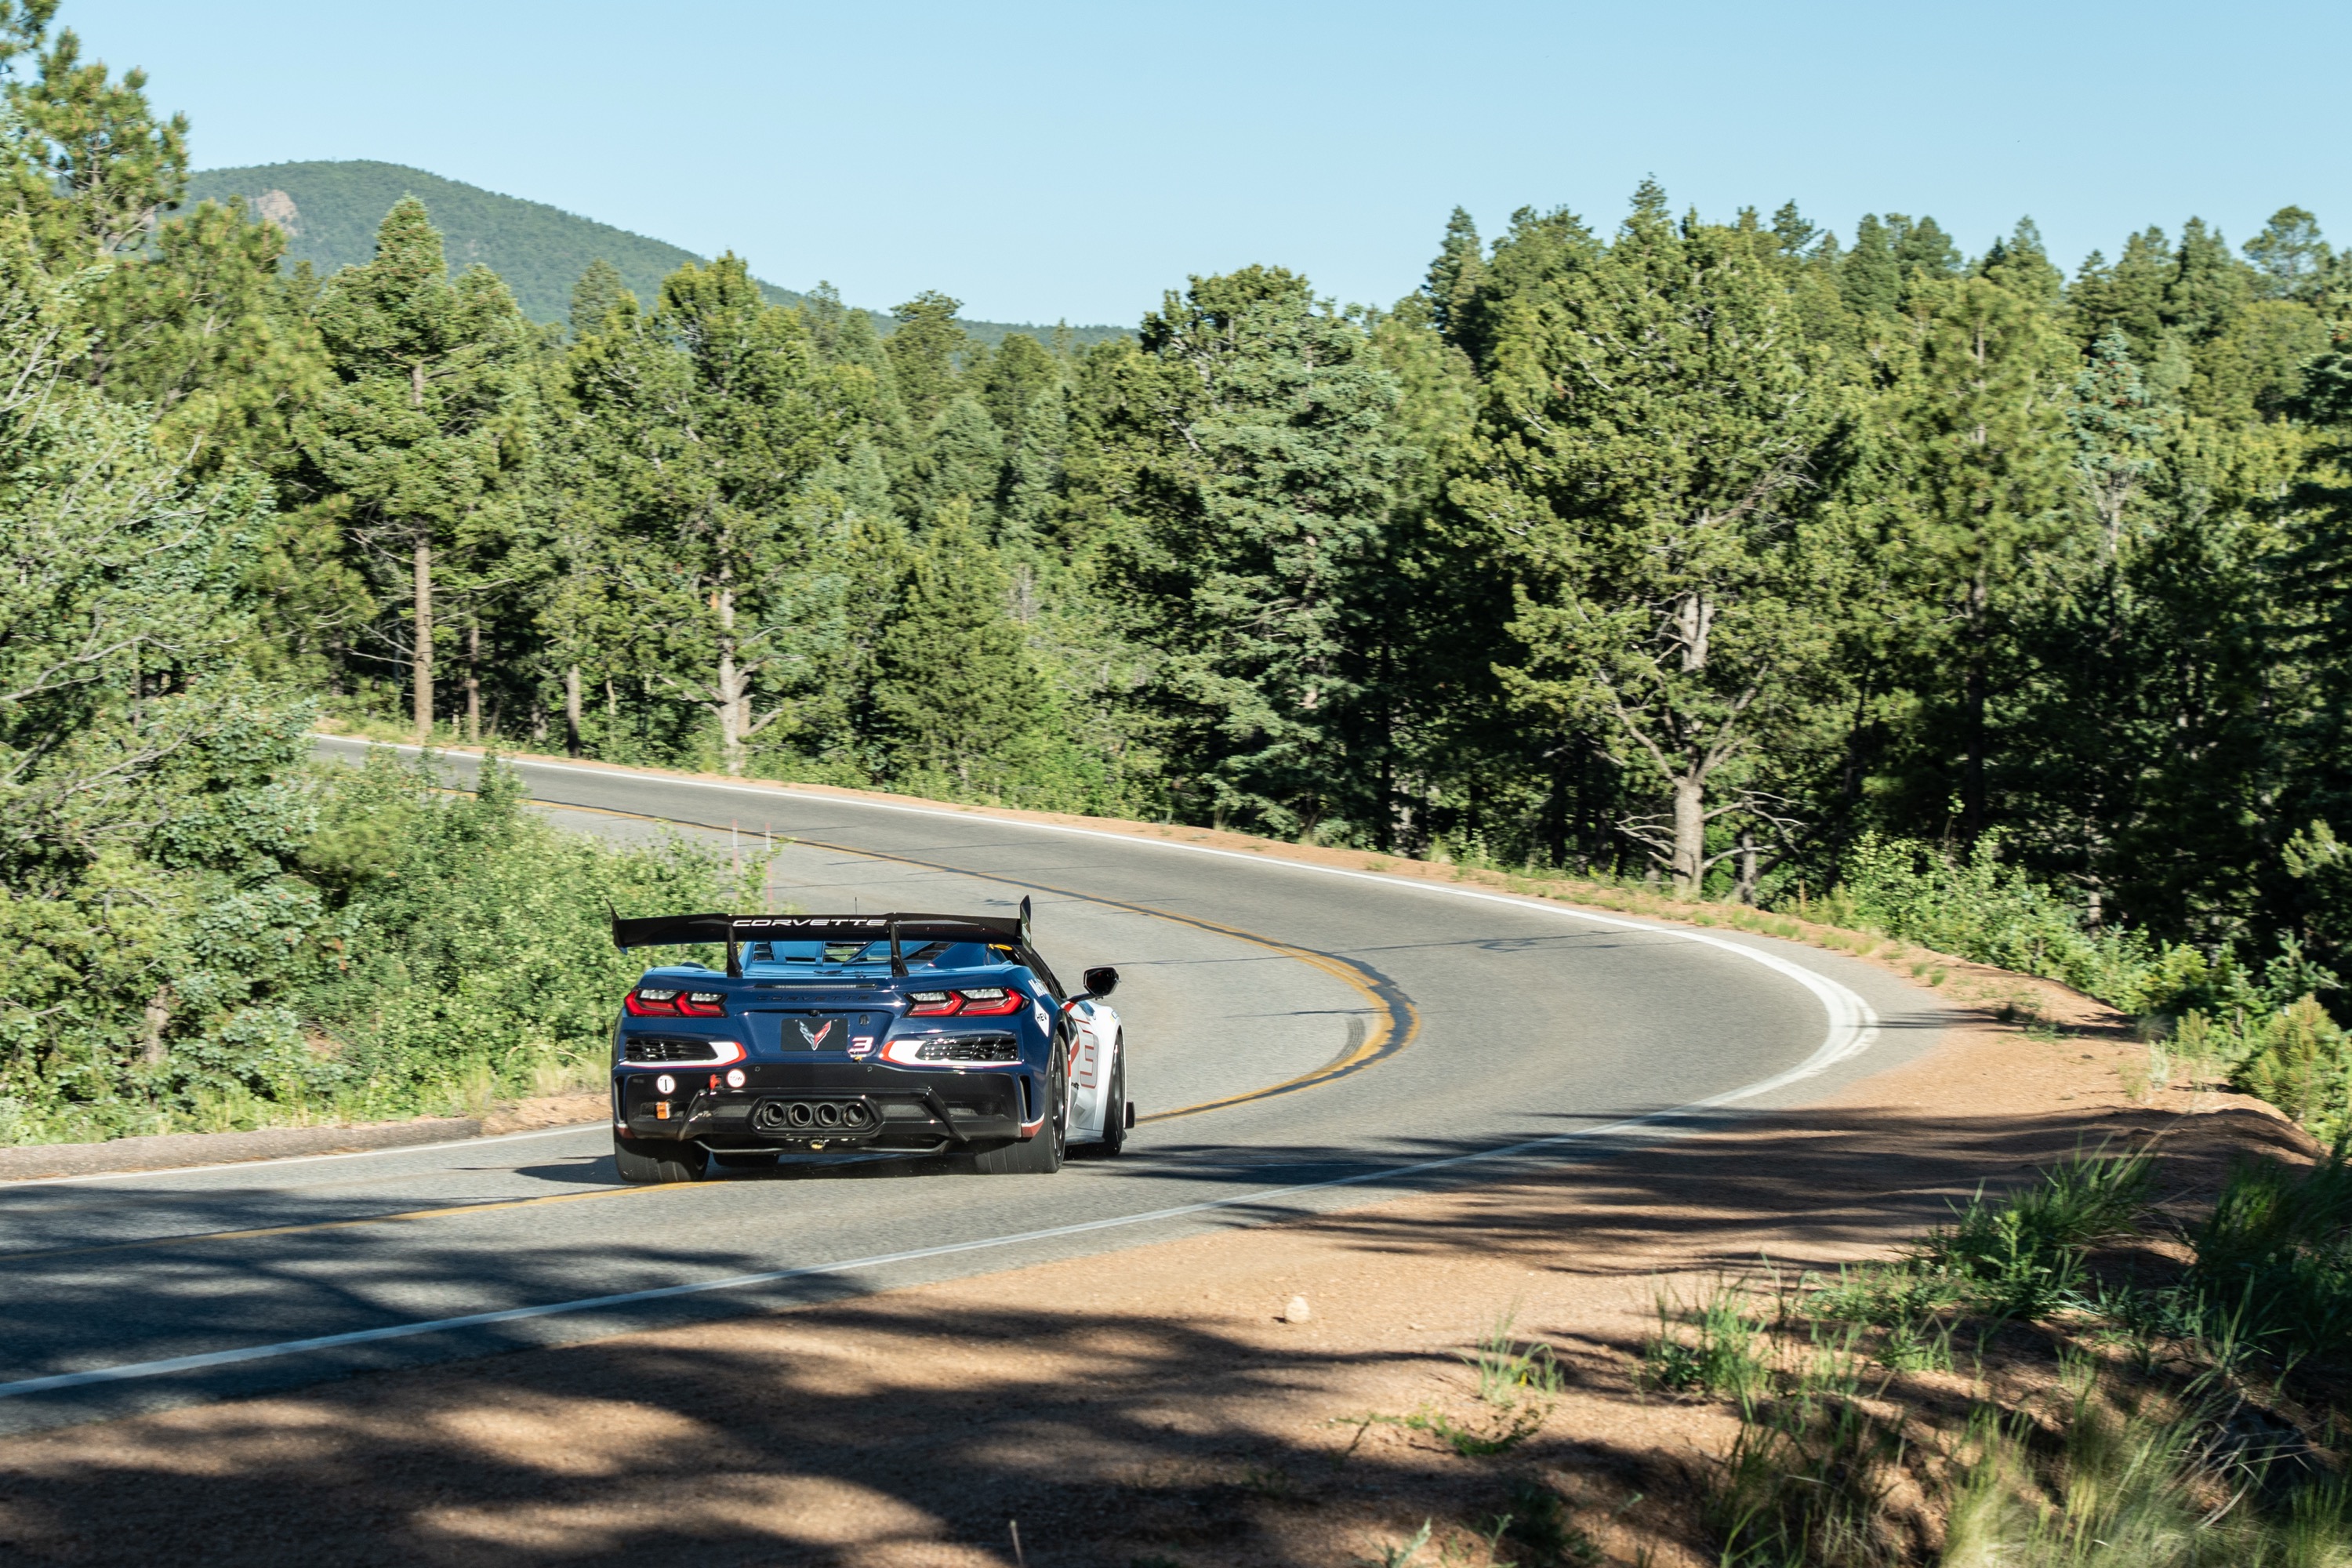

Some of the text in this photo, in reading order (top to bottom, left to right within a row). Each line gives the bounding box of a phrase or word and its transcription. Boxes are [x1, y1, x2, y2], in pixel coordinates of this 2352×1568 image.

[732, 919, 887, 927] CORVETTE
[1036, 1011, 1047, 1022] HEV
[848, 1036, 873, 1053] 3
[1074, 1018, 1100, 1089] 3
[659, 1079, 672, 1091] T
